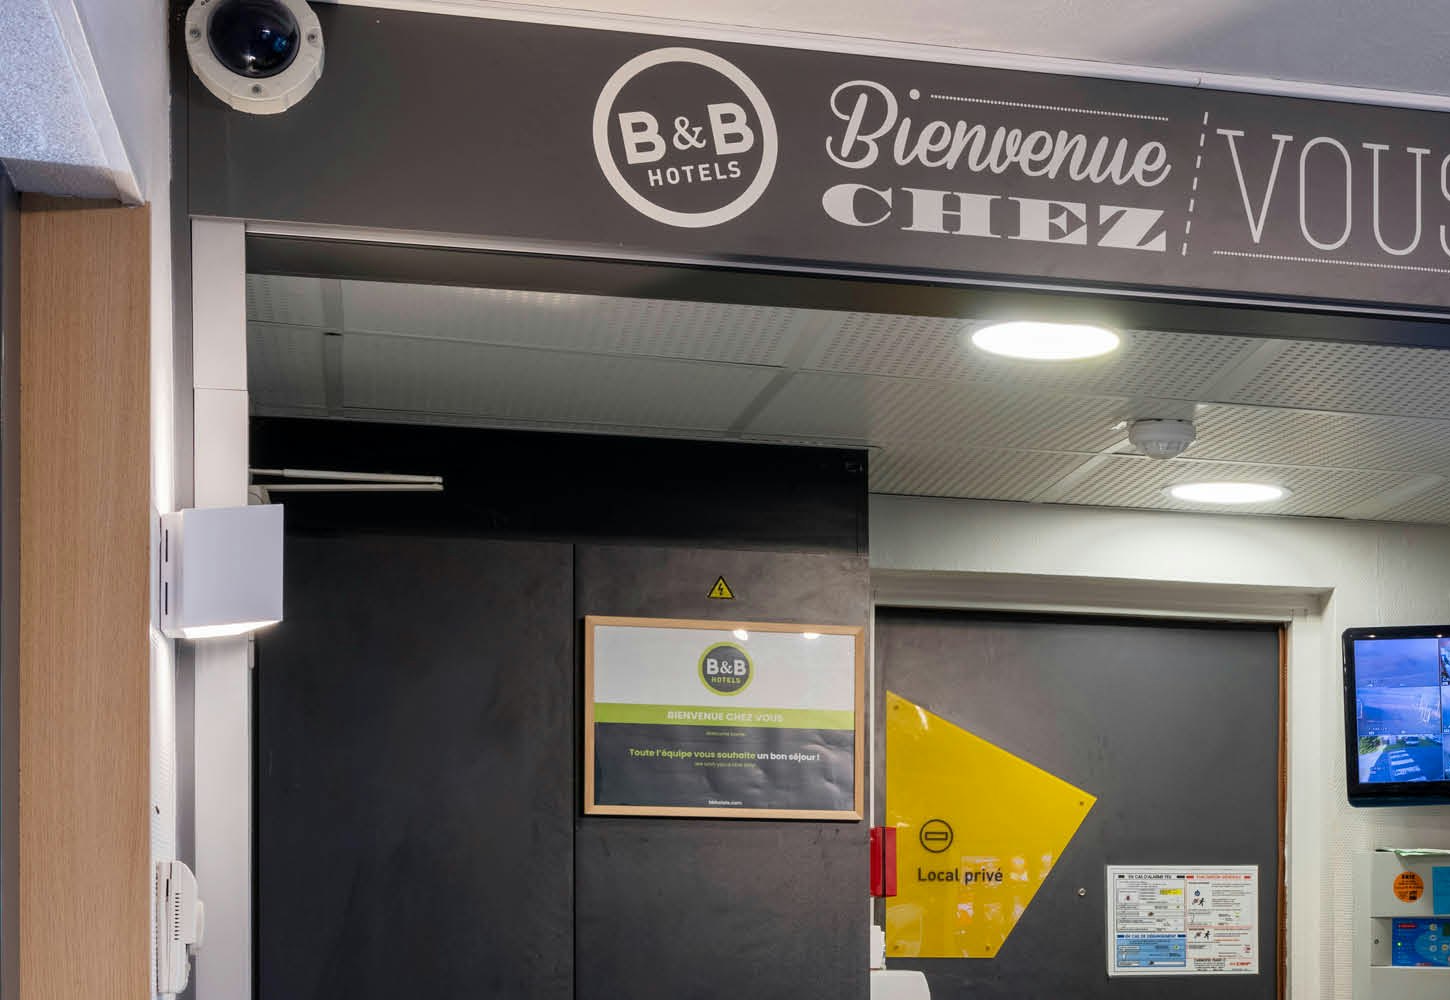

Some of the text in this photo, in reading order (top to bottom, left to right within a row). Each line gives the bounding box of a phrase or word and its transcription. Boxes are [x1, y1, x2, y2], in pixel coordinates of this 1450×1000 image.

[619, 101, 756, 166] B&B
[825, 78, 1171, 188] Bienvenue
[647, 160, 741, 188] HOTELS
[821, 182, 1168, 252] CHEZ
[706, 658, 747, 676] B&B
[711, 676, 741, 684] HOTELS
[667, 711, 783, 722] BIENVENUE CHEZ VOUS
[629, 748, 655, 757] Toute
[656, 749, 692, 759] l'équipe
[717, 751, 756, 760] souhaite
[771, 752, 787, 760] bon
[789, 753, 815, 762] séjour
[917, 866, 1004, 885] Local privé
